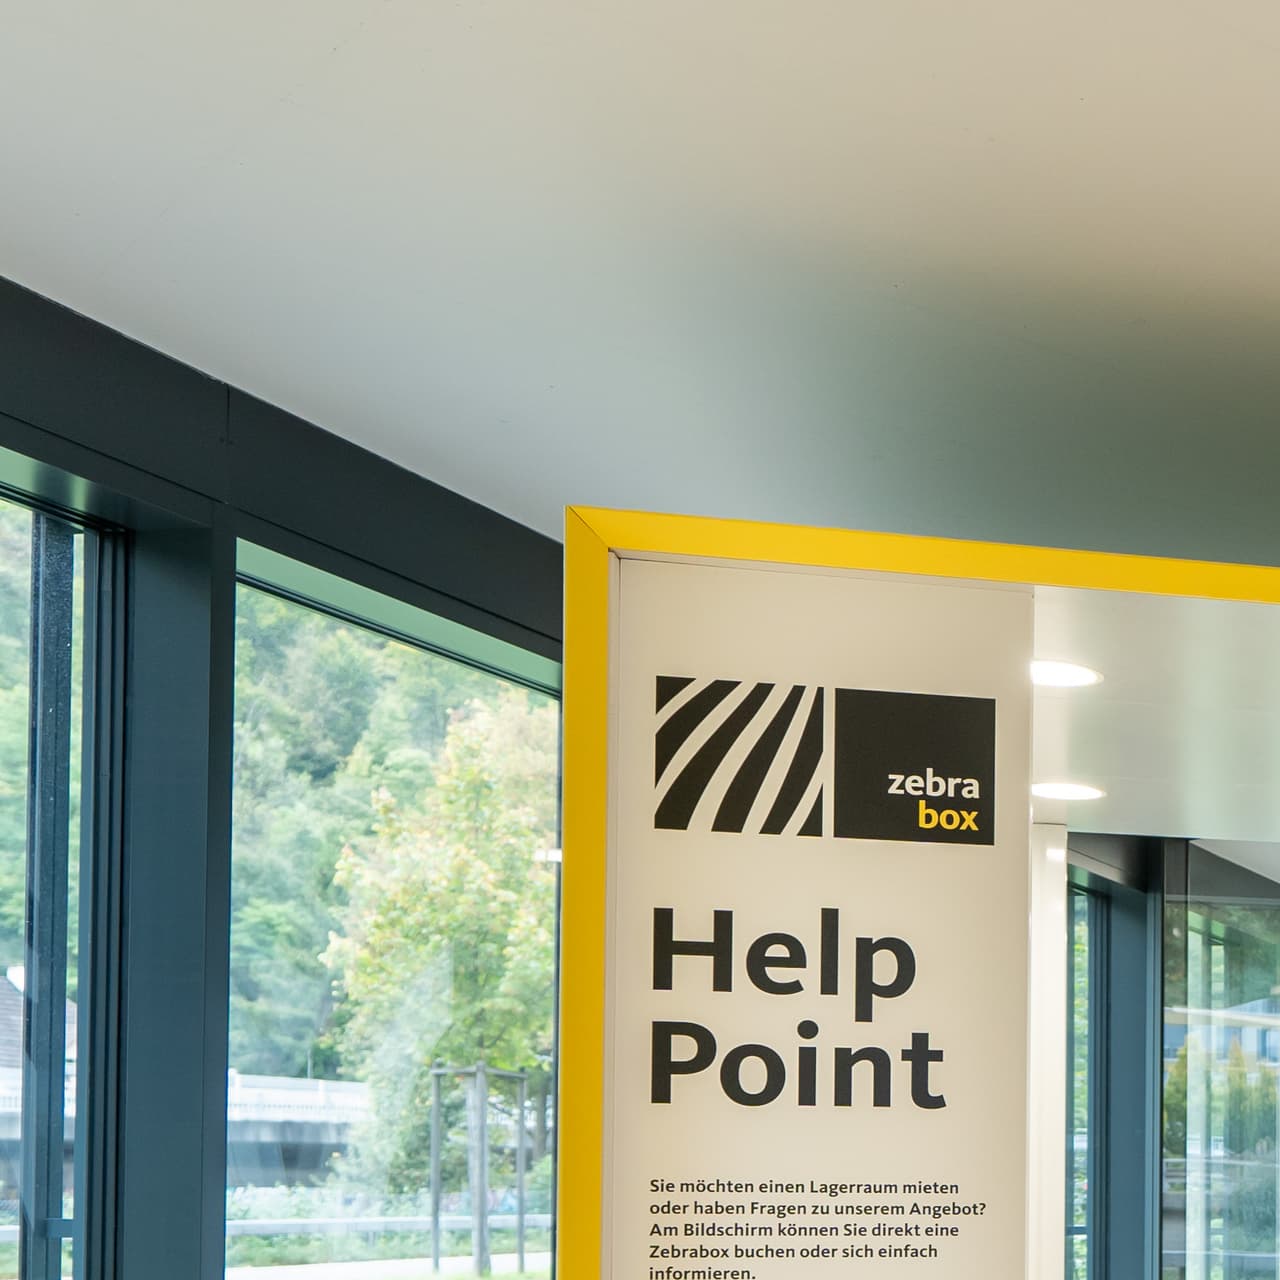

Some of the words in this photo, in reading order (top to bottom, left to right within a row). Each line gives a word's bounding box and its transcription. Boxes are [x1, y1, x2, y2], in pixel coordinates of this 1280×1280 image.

[887, 767, 980, 799] zebra
[917, 800, 979, 831] box
[652, 907, 916, 1023] Help
[650, 1019, 946, 1110] Point
[649, 1178, 676, 1193] Sie
[680, 1178, 754, 1193] möchten
[758, 1179, 805, 1194] einen
[810, 1180, 898, 1198] Lagerraum
[902, 1180, 959, 1194] mieten
[649, 1200, 690, 1215] oder
[693, 1200, 746, 1217] haben
[750, 1201, 807, 1219] Fragen
[810, 1204, 830, 1215] zu
[834, 1204, 905, 1216] unserem
[908, 1201, 986, 1220] Angebot?
[649, 1223, 679, 1237] Am
[683, 1222, 773, 1240] Bildschirm
[777, 1222, 839, 1237] können
[843, 1222, 868, 1237] Sie
[871, 1222, 921, 1240] direkt
[922, 1222, 959, 1237] eine
[649, 1244, 730, 1259] Zebrabox
[734, 1244, 796, 1259] buchen
[799, 1244, 839, 1258] oder
[842, 1243, 874, 1258] sich
[878, 1243, 938, 1258] einfach
[649, 1266, 756, 1280] informieren.
